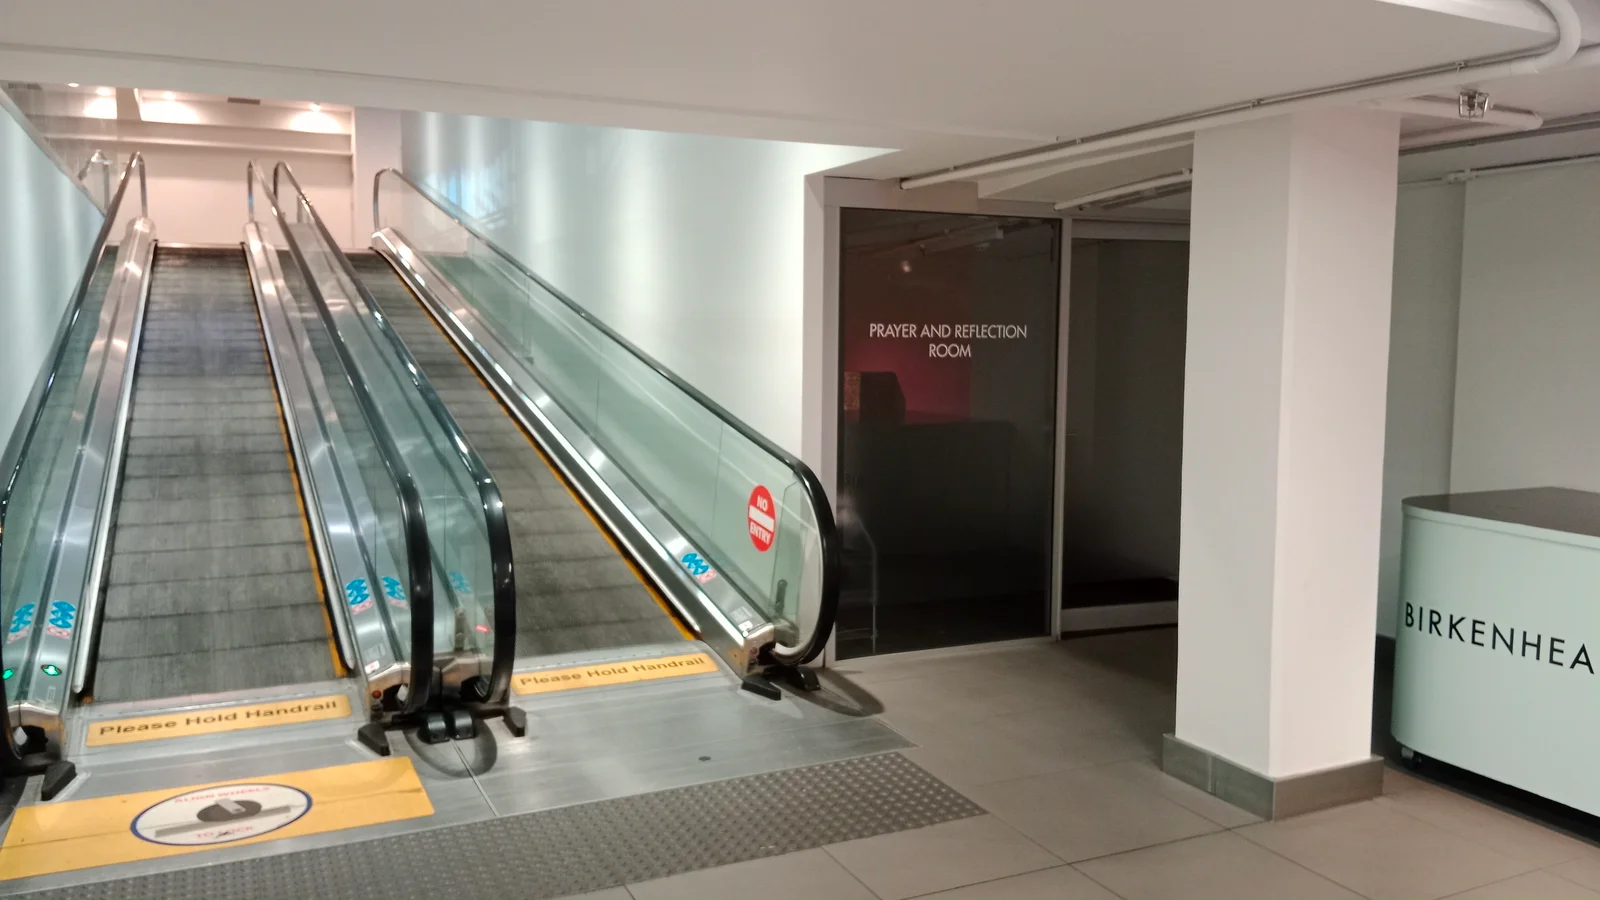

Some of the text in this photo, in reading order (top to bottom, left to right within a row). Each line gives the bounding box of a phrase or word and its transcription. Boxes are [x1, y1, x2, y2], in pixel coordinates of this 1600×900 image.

[869, 323, 1027, 339] PRAYER AND REFLECTION
[929, 343, 971, 358] ROOM
[756, 495, 769, 512] NO
[750, 521, 772, 545] ENTRY
[1405, 601, 1595, 675] BIRKENHEA
[520, 657, 705, 686] Please Hold Handrail
[99, 701, 337, 735] Please Hold Handrail
